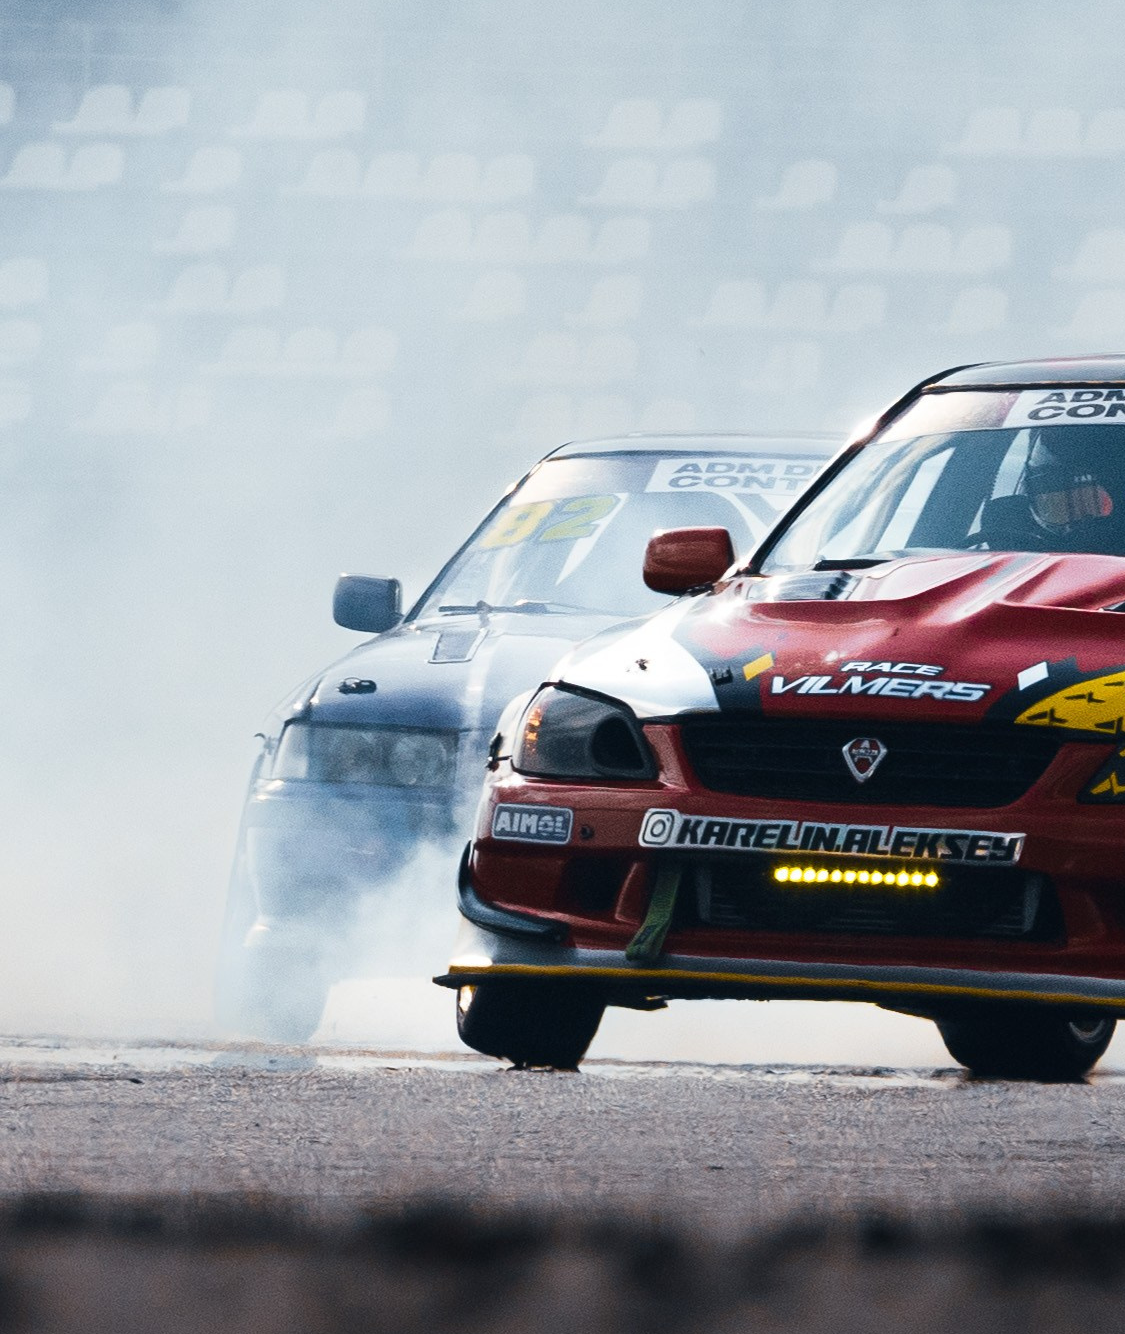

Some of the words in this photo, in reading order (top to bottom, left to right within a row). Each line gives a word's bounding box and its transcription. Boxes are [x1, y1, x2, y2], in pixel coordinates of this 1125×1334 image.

[673, 462, 775, 474] ADM
[840, 661, 943, 676] RACE
[771, 676, 991, 701] VILMERS
[495, 811, 567, 836] AIMOL
